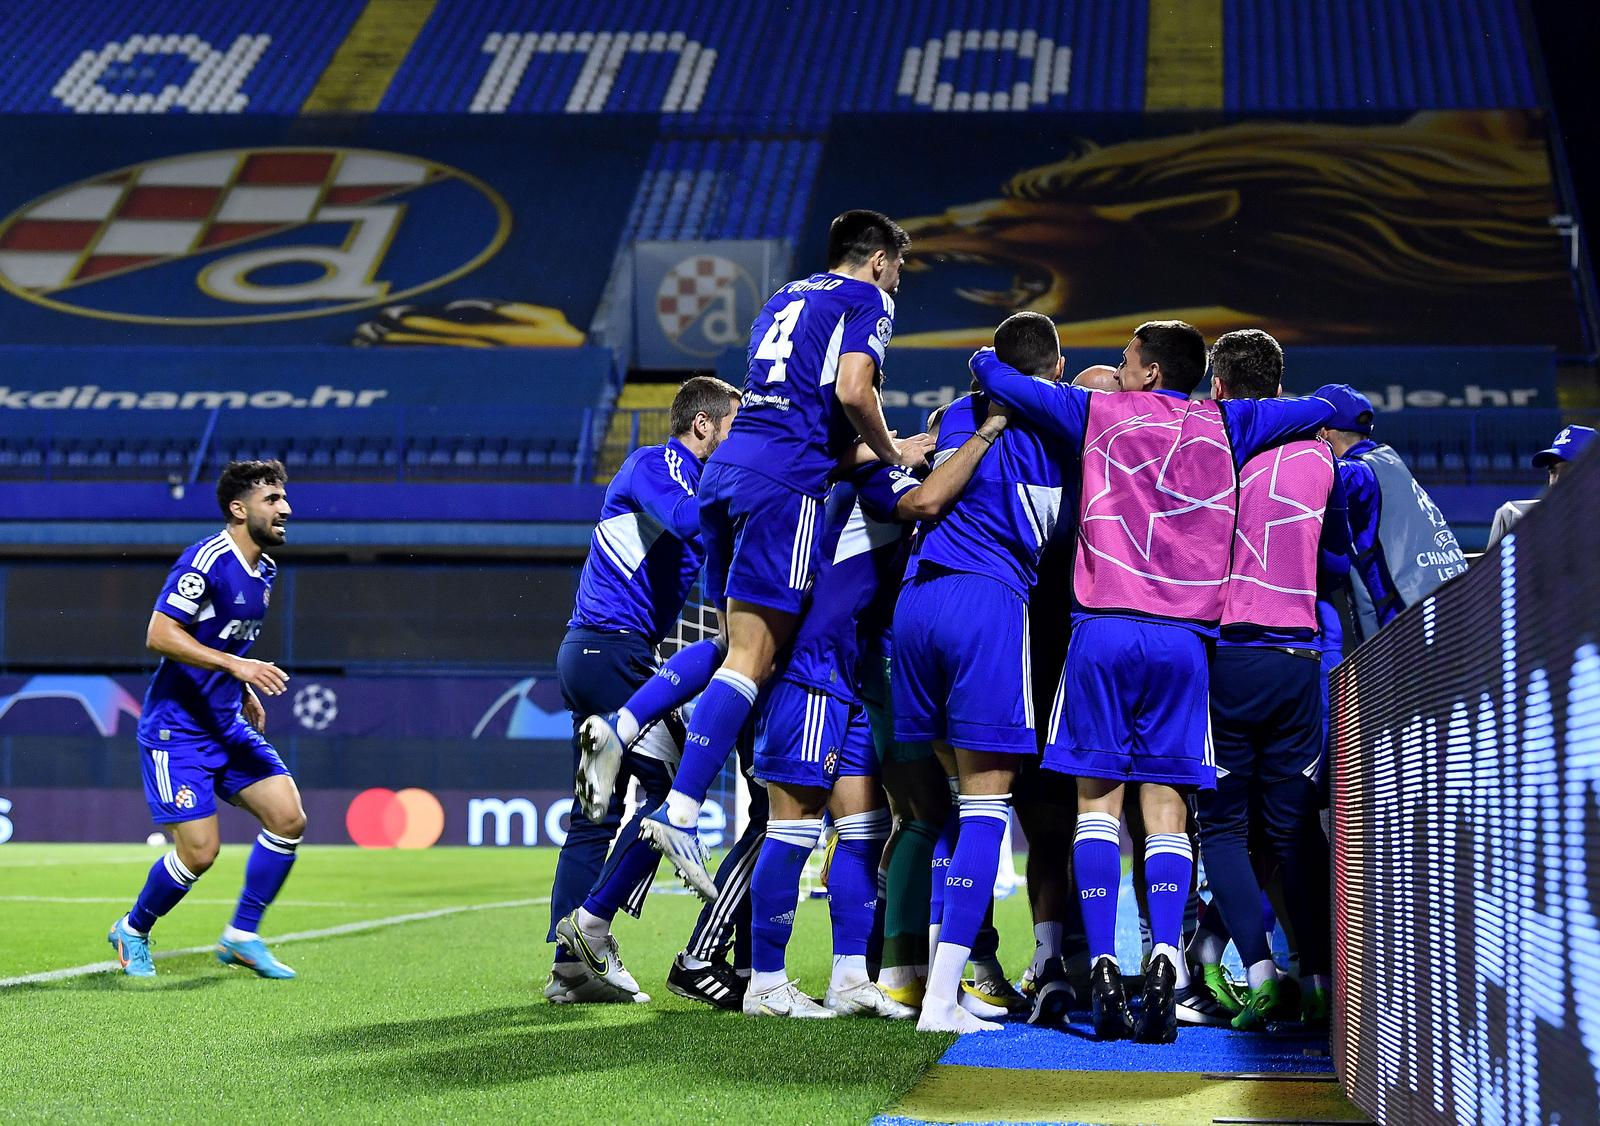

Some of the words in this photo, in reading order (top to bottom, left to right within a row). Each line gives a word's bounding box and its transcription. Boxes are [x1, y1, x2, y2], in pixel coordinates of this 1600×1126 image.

[754, 299, 805, 383] 4
[946, 876, 974, 888] DZG
[1151, 882, 1178, 894] DZG
[1081, 887, 1107, 900] DZG
